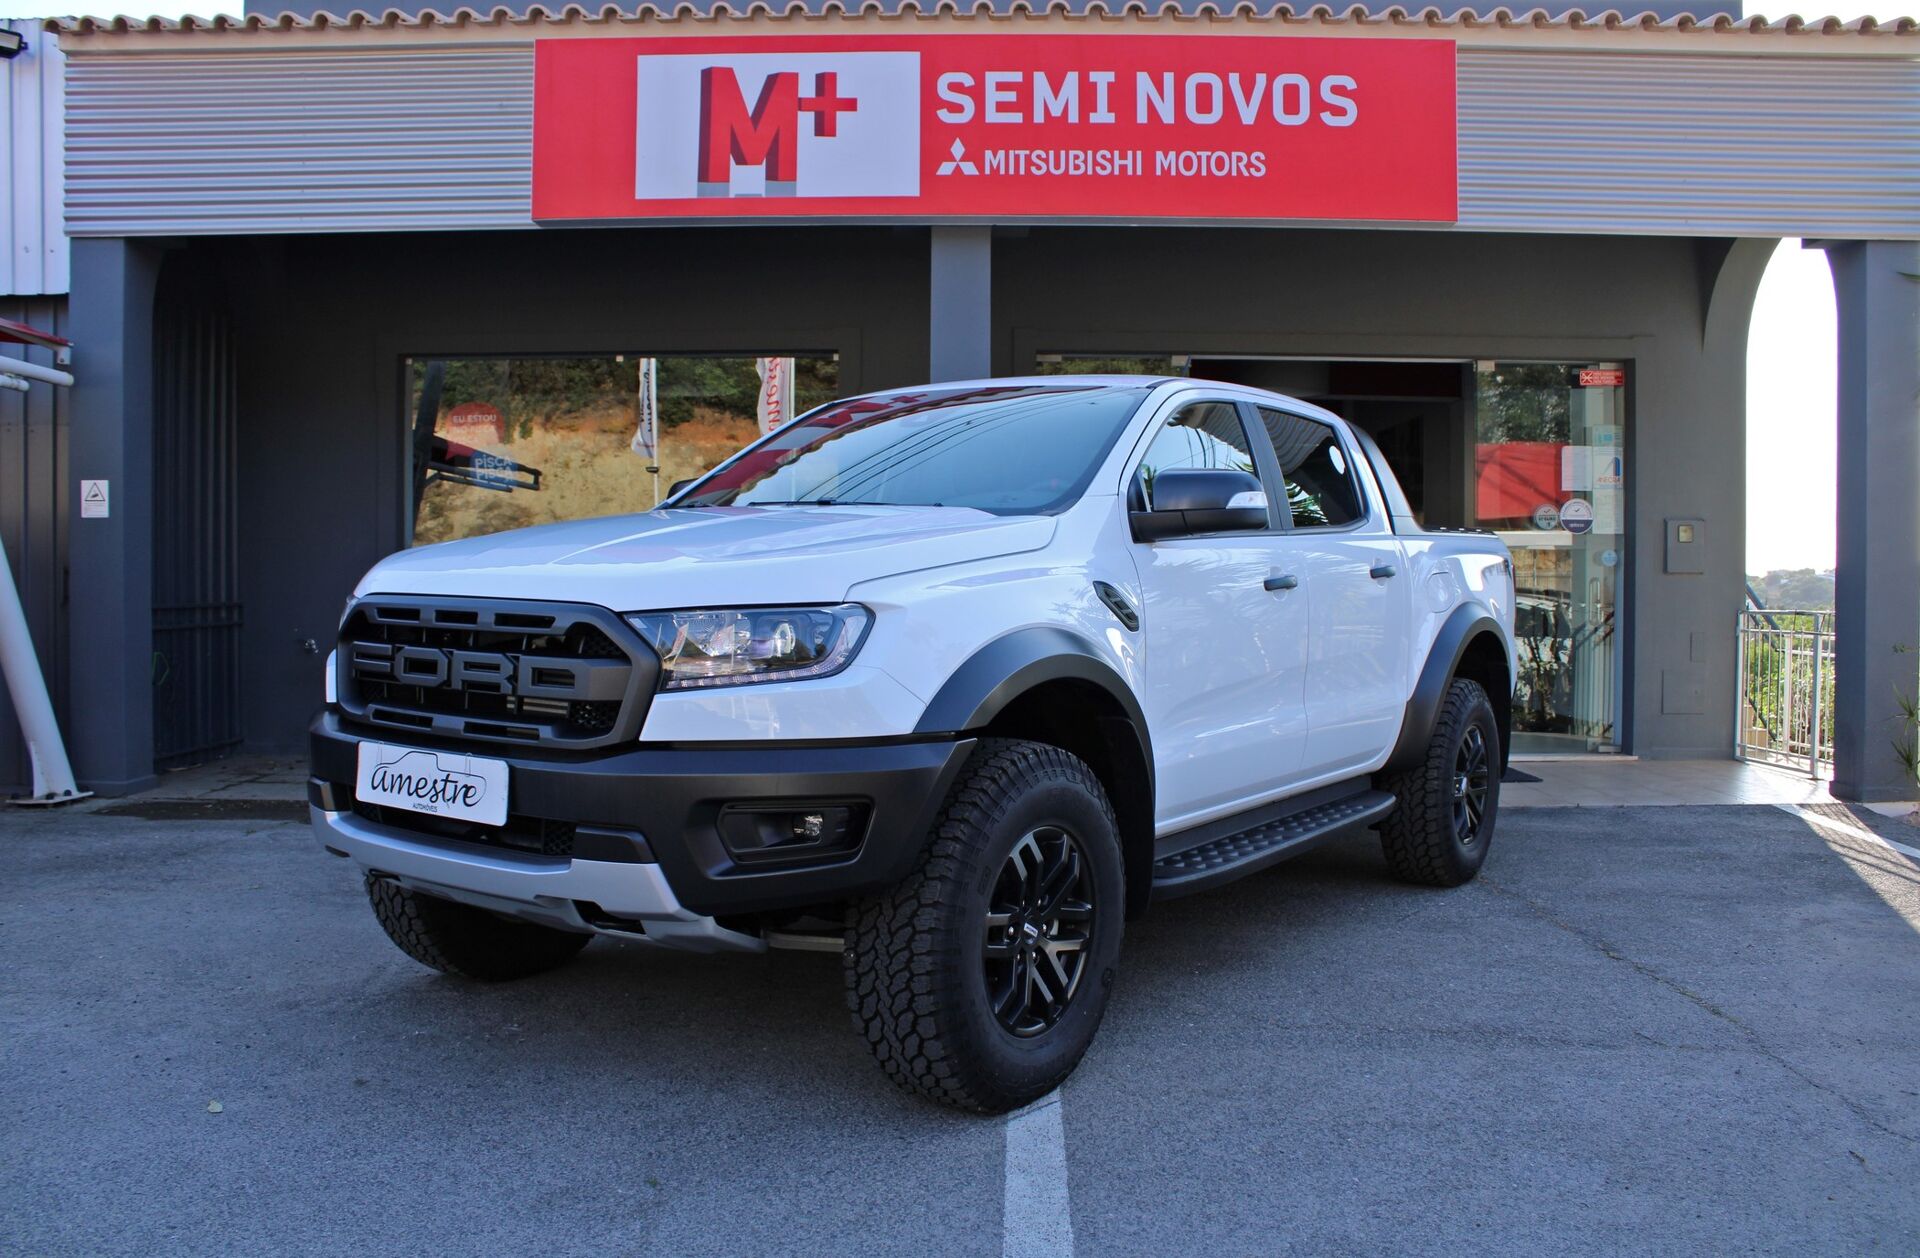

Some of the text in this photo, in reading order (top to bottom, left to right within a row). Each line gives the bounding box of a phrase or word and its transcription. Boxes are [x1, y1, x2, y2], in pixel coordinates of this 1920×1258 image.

[936, 71, 1358, 127] SEMI NOVOS
[984, 149, 1266, 177] MITSUBISHI MOTORS
[452, 414, 497, 424] EU ESTOU
[353, 641, 590, 700] FORD
[371, 765, 478, 807] amestre
